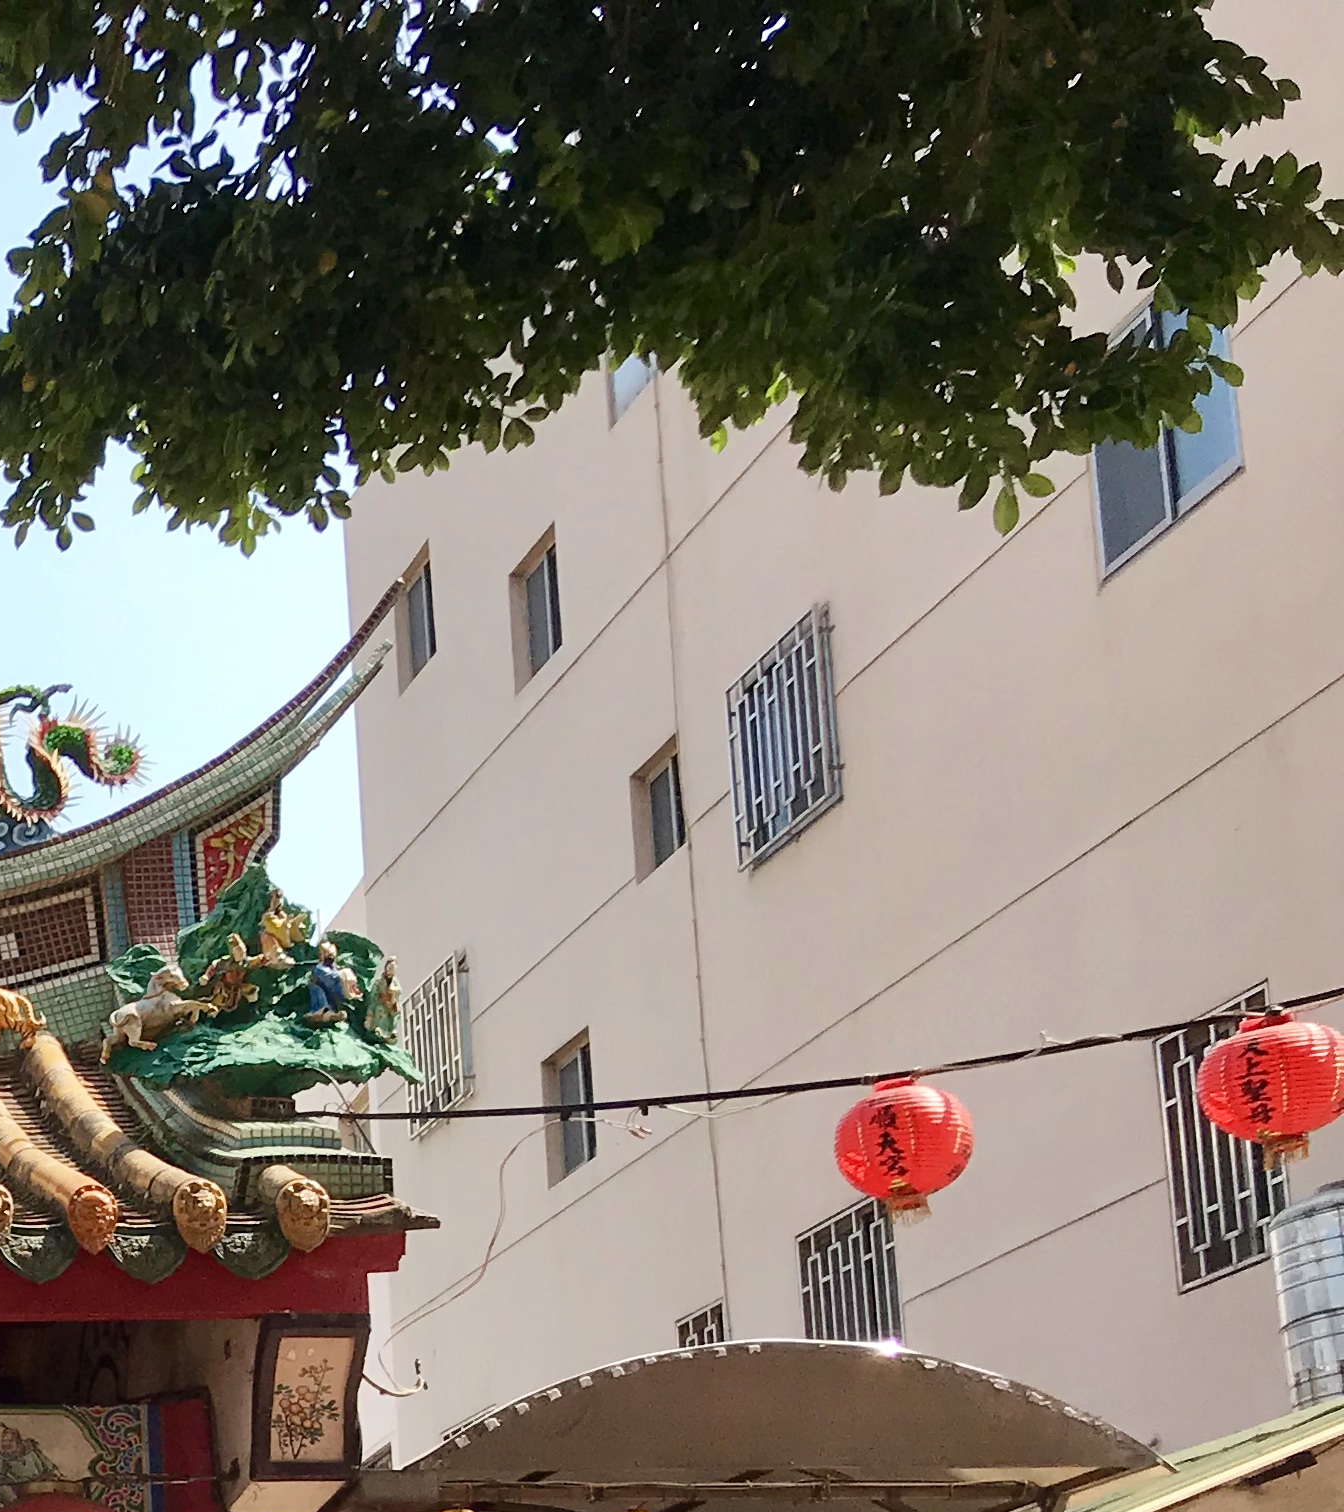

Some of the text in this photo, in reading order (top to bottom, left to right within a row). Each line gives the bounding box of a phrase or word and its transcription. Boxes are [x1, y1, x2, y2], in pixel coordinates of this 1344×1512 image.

[1236, 1038, 1277, 1126] 天上聖母
[870, 1103, 909, 1177] 順天宮
